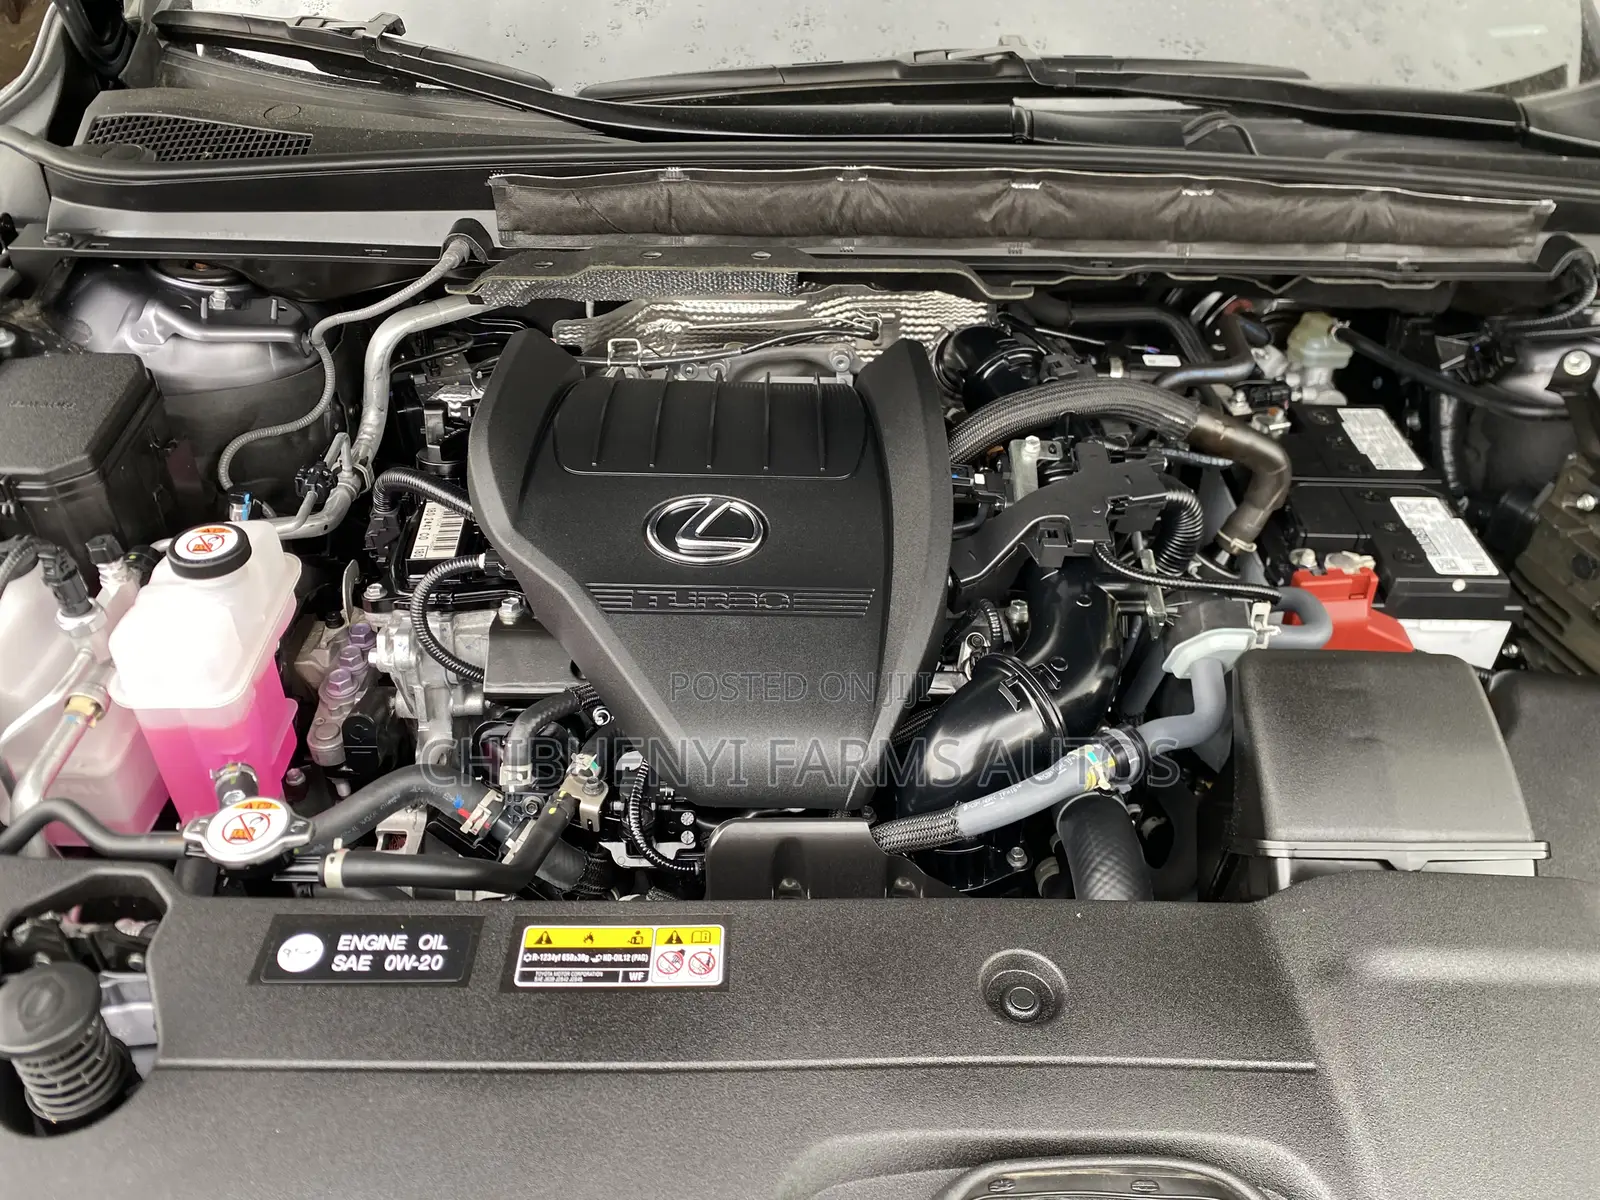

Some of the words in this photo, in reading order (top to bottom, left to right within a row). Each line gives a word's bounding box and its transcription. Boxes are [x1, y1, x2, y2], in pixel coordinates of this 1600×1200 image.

[637, 590, 790, 609] TURBO
[337, 934, 408, 951] ENGINE
[418, 934, 449, 951] OIL
[331, 954, 373, 971] SAE
[384, 954, 444, 971] 0W-20
[628, 971, 645, 981] WF
